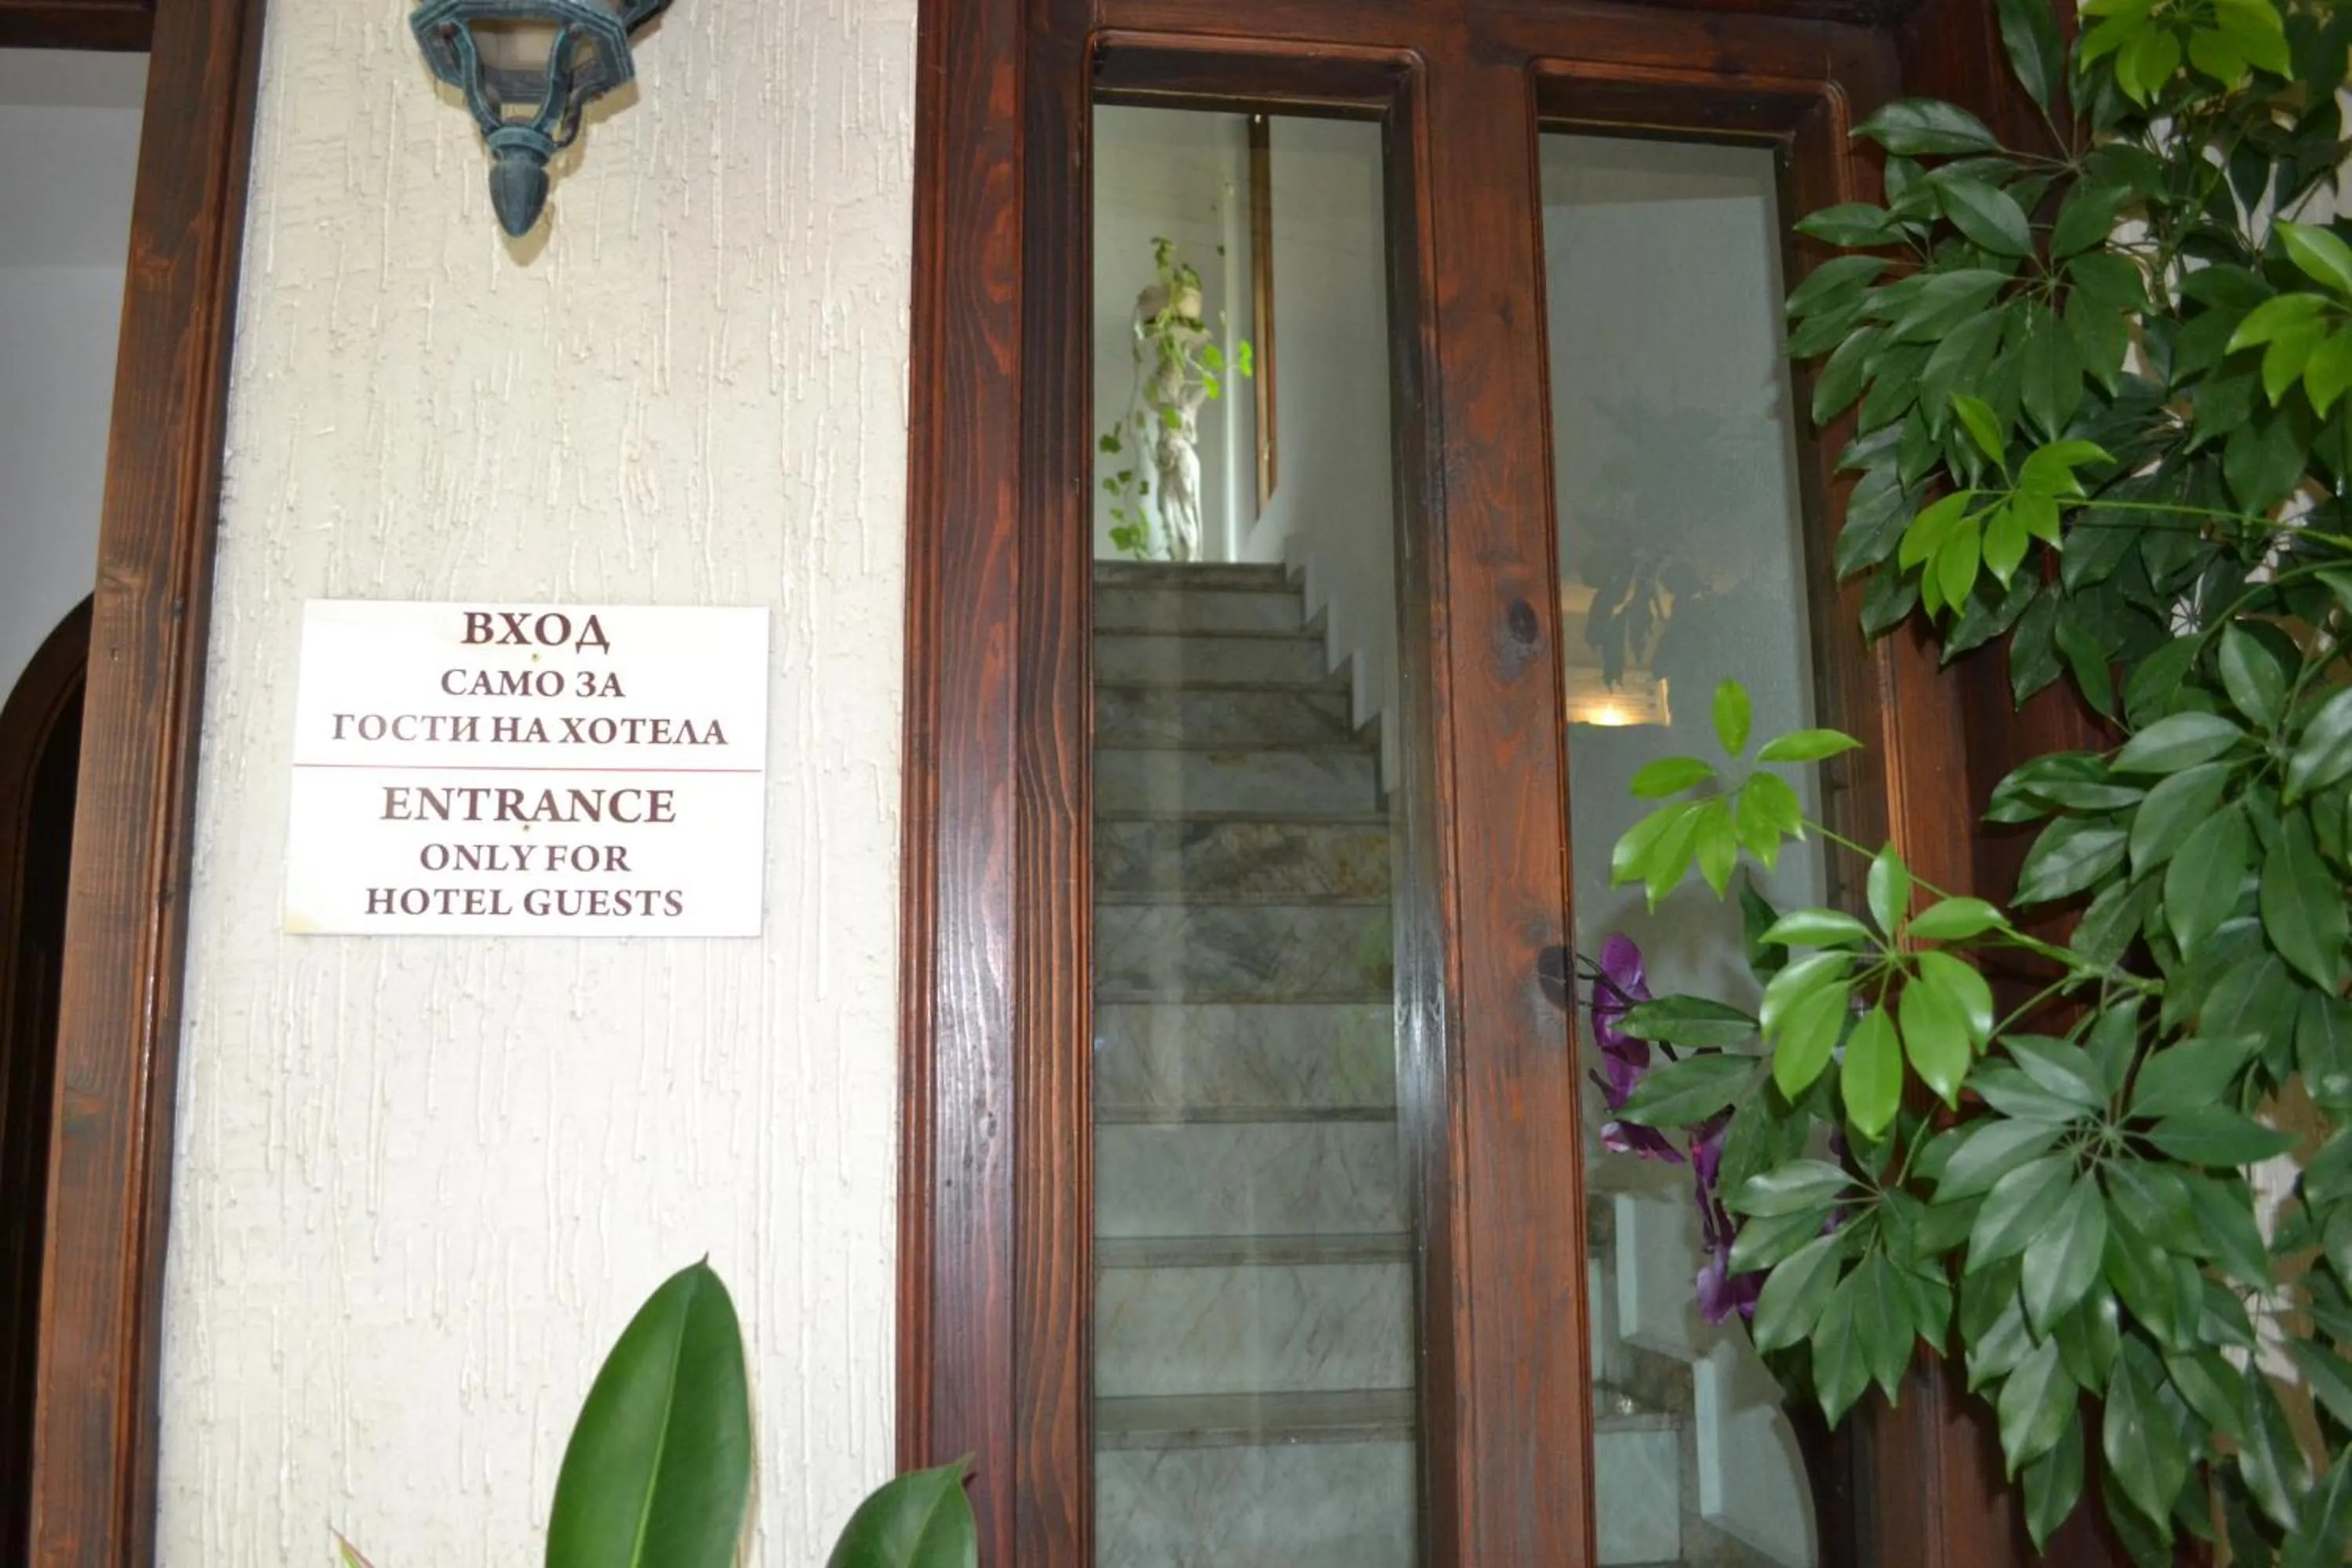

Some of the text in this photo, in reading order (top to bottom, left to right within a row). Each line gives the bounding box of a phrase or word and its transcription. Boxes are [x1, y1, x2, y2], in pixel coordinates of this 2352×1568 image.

[461, 612, 610, 655] ВХОД
[441, 670, 626, 697] САМО ЗА
[333, 714, 728, 745] ГОСТИ НА ХОТЕЛА
[380, 787, 676, 823] ENTRANCE
[420, 844, 631, 872] ONLY FOR
[365, 888, 682, 916] HOTEL GUESTS
